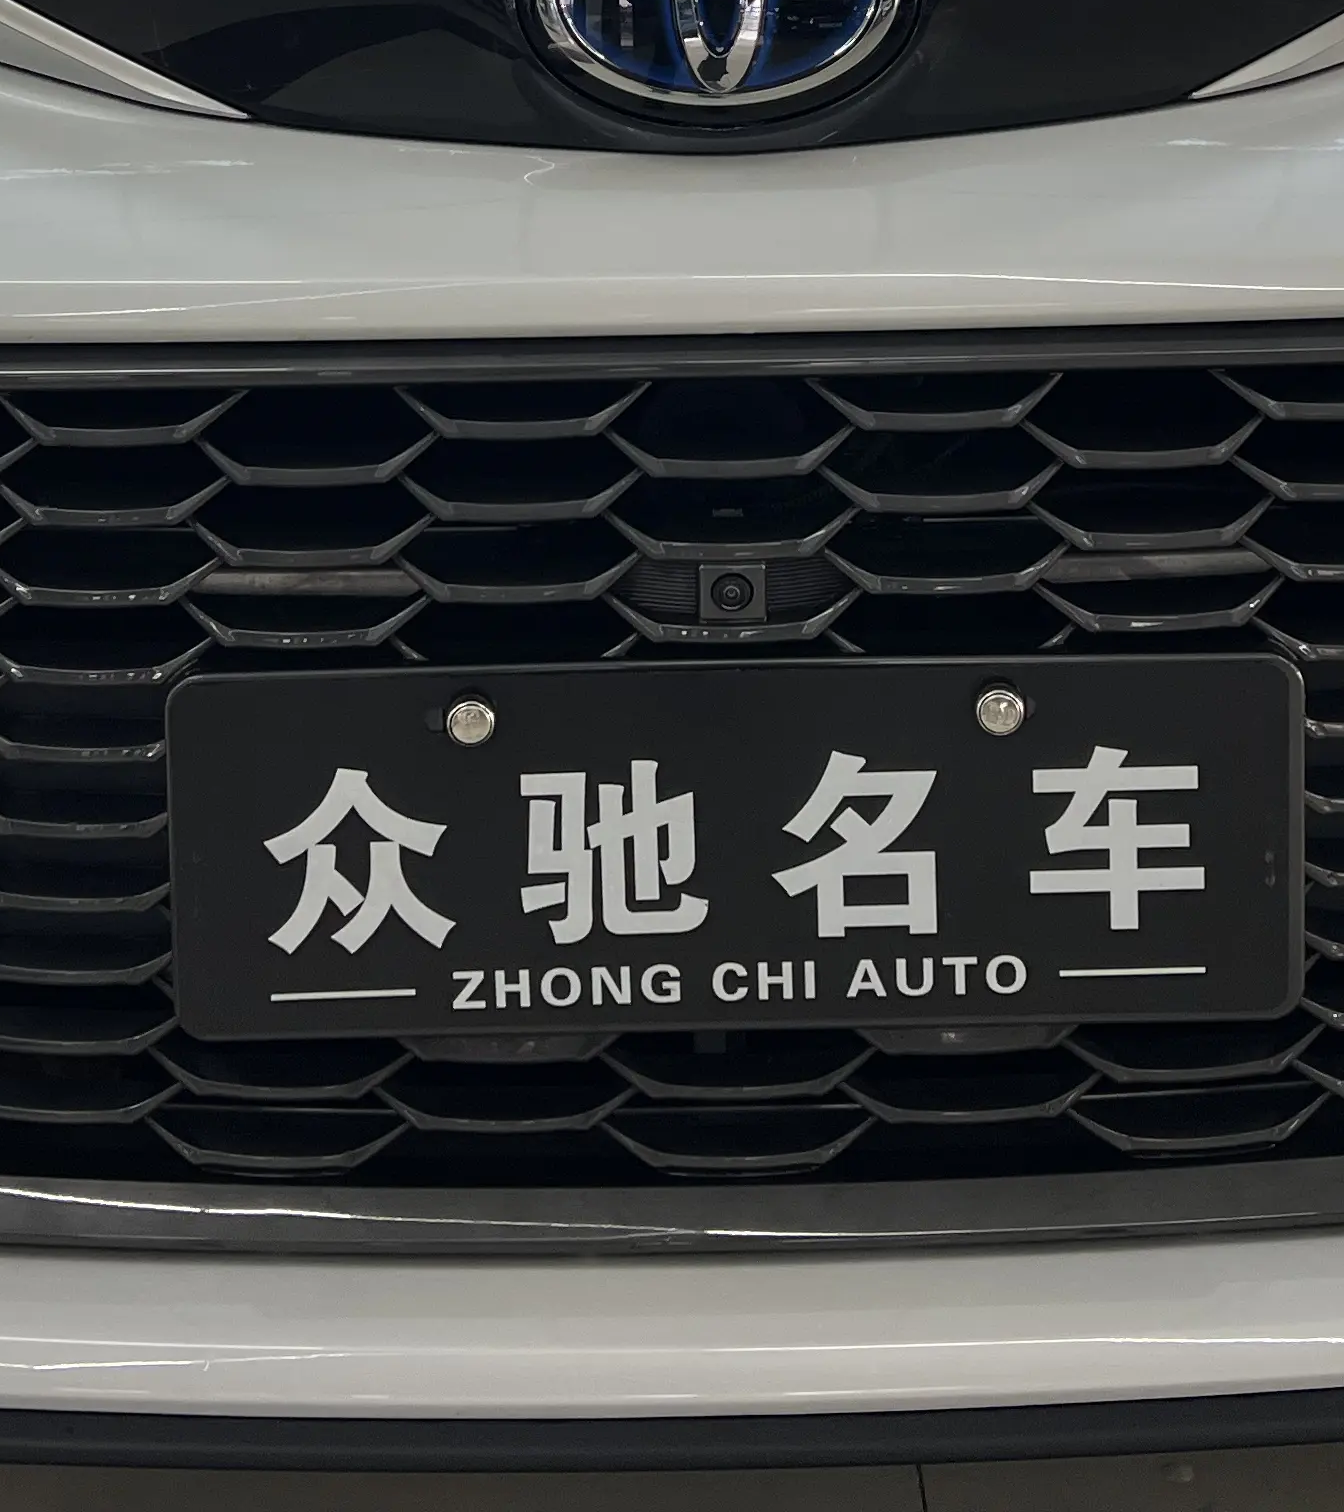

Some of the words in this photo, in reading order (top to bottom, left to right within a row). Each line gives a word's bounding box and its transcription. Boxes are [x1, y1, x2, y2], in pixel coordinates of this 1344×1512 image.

[263, 745, 1206, 955] 众驰名车
[452, 963, 681, 1010] ZHONG
[713, 960, 816, 1002] CHI
[846, 954, 1027, 998] AUTO
